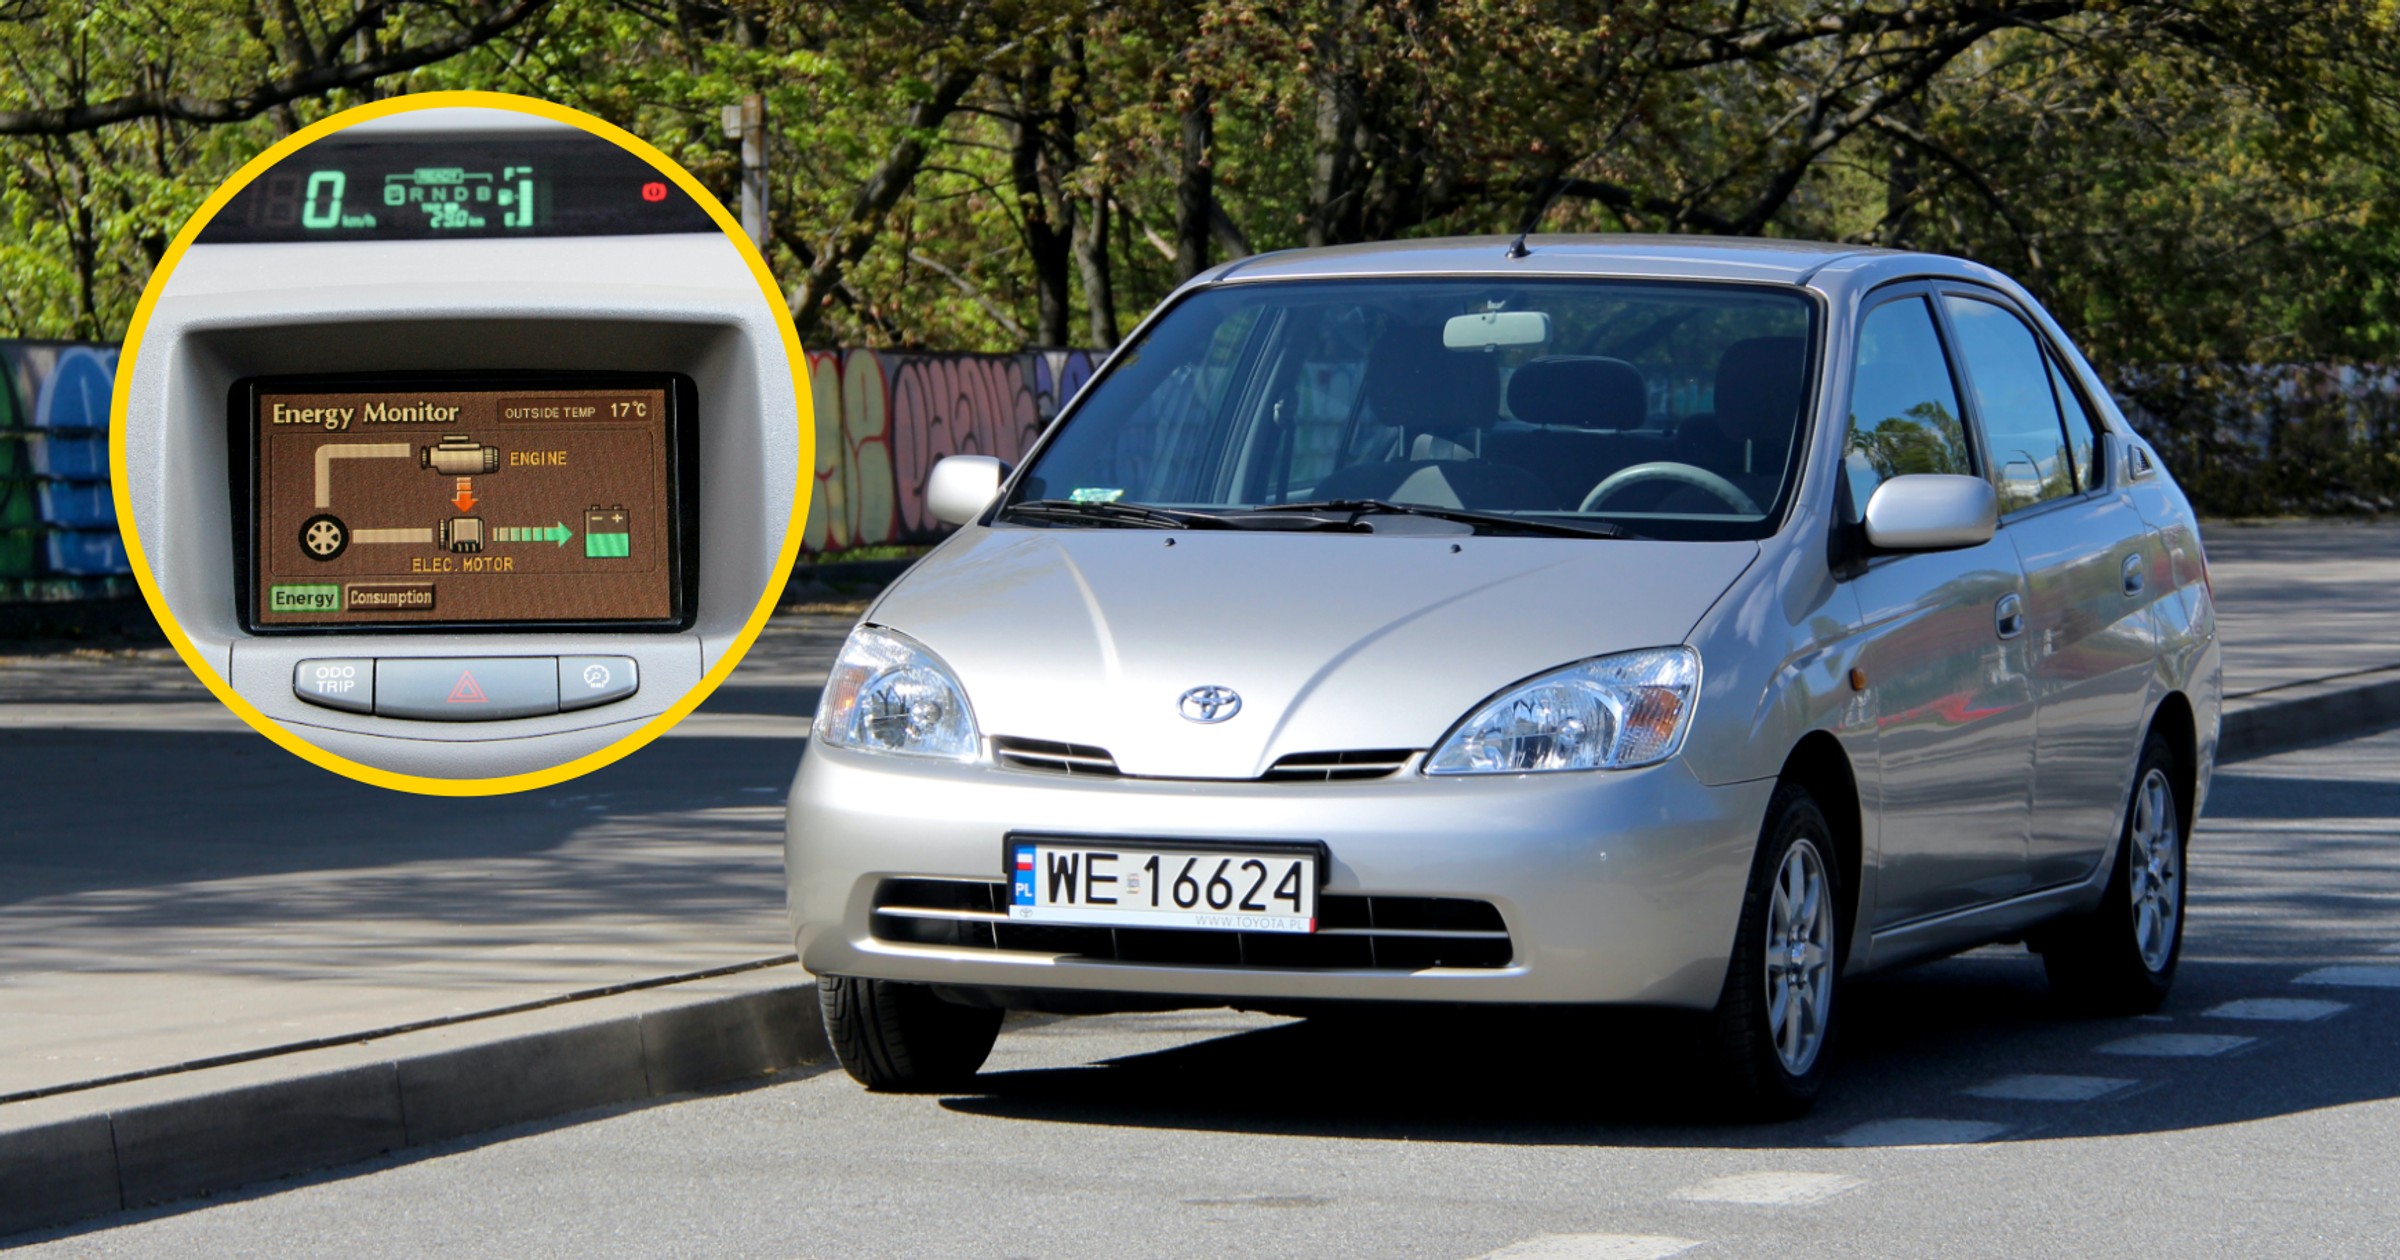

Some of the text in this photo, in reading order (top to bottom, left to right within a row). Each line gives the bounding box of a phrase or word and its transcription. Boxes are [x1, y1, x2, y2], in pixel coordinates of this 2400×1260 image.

[302, 171, 376, 228] 0 km/h
[409, 187, 424, 201] R
[431, 187, 447, 201] N
[454, 187, 469, 201] D
[272, 401, 459, 430] Energy Monitor
[504, 406, 596, 419] OUTSIDE TEMP
[509, 450, 567, 466] ENGINE
[275, 589, 335, 608] Energy
[350, 589, 432, 607] Consumption
[315, 665, 355, 679] ODO
[315, 680, 355, 693] TRIP
[1015, 882, 1033, 897] PL
[1047, 852, 1303, 913] WE 16624
